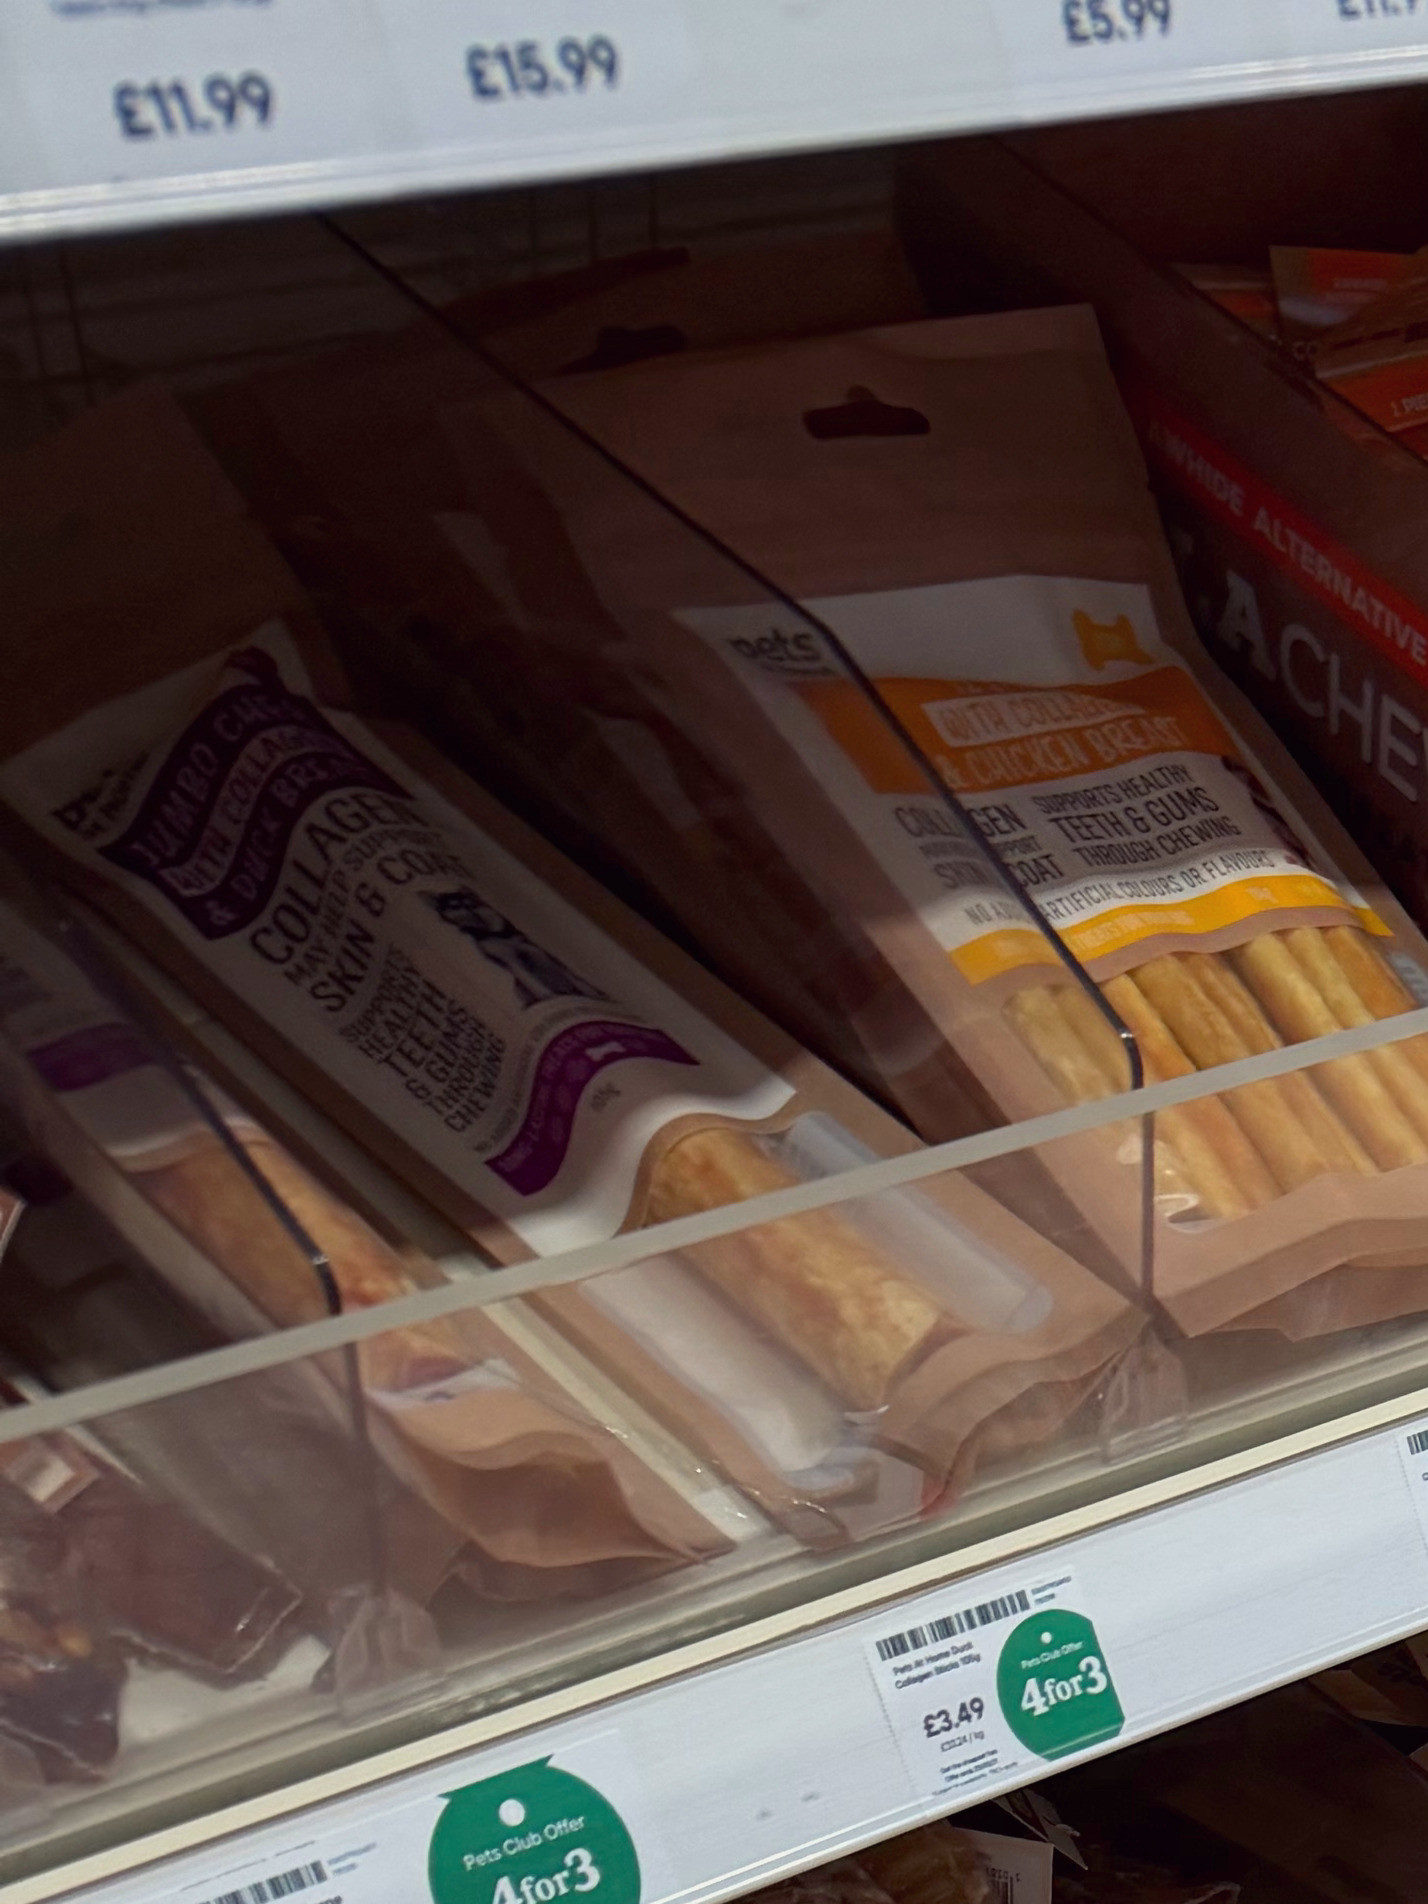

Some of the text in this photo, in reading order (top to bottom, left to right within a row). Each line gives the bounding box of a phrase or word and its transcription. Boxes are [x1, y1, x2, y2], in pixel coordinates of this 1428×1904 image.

[466, 36, 618, 99] £15.99
[113, 72, 272, 140] £11.99
[1254, 507, 1428, 667] ALTERNATIVE
[1032, 763, 1191, 814] SUPPORTS HEALTHY
[1048, 787, 1220, 844] TEETH GUMS
[1071, 815, 1242, 868] THROUGH CHEWING
[1123, 872, 1183, 899] COLOURS
[1020, 1655, 1108, 1716] 4for3
[923, 1697, 985, 1738] £3.49
[464, 1815, 586, 1871] Pets Club Offer
